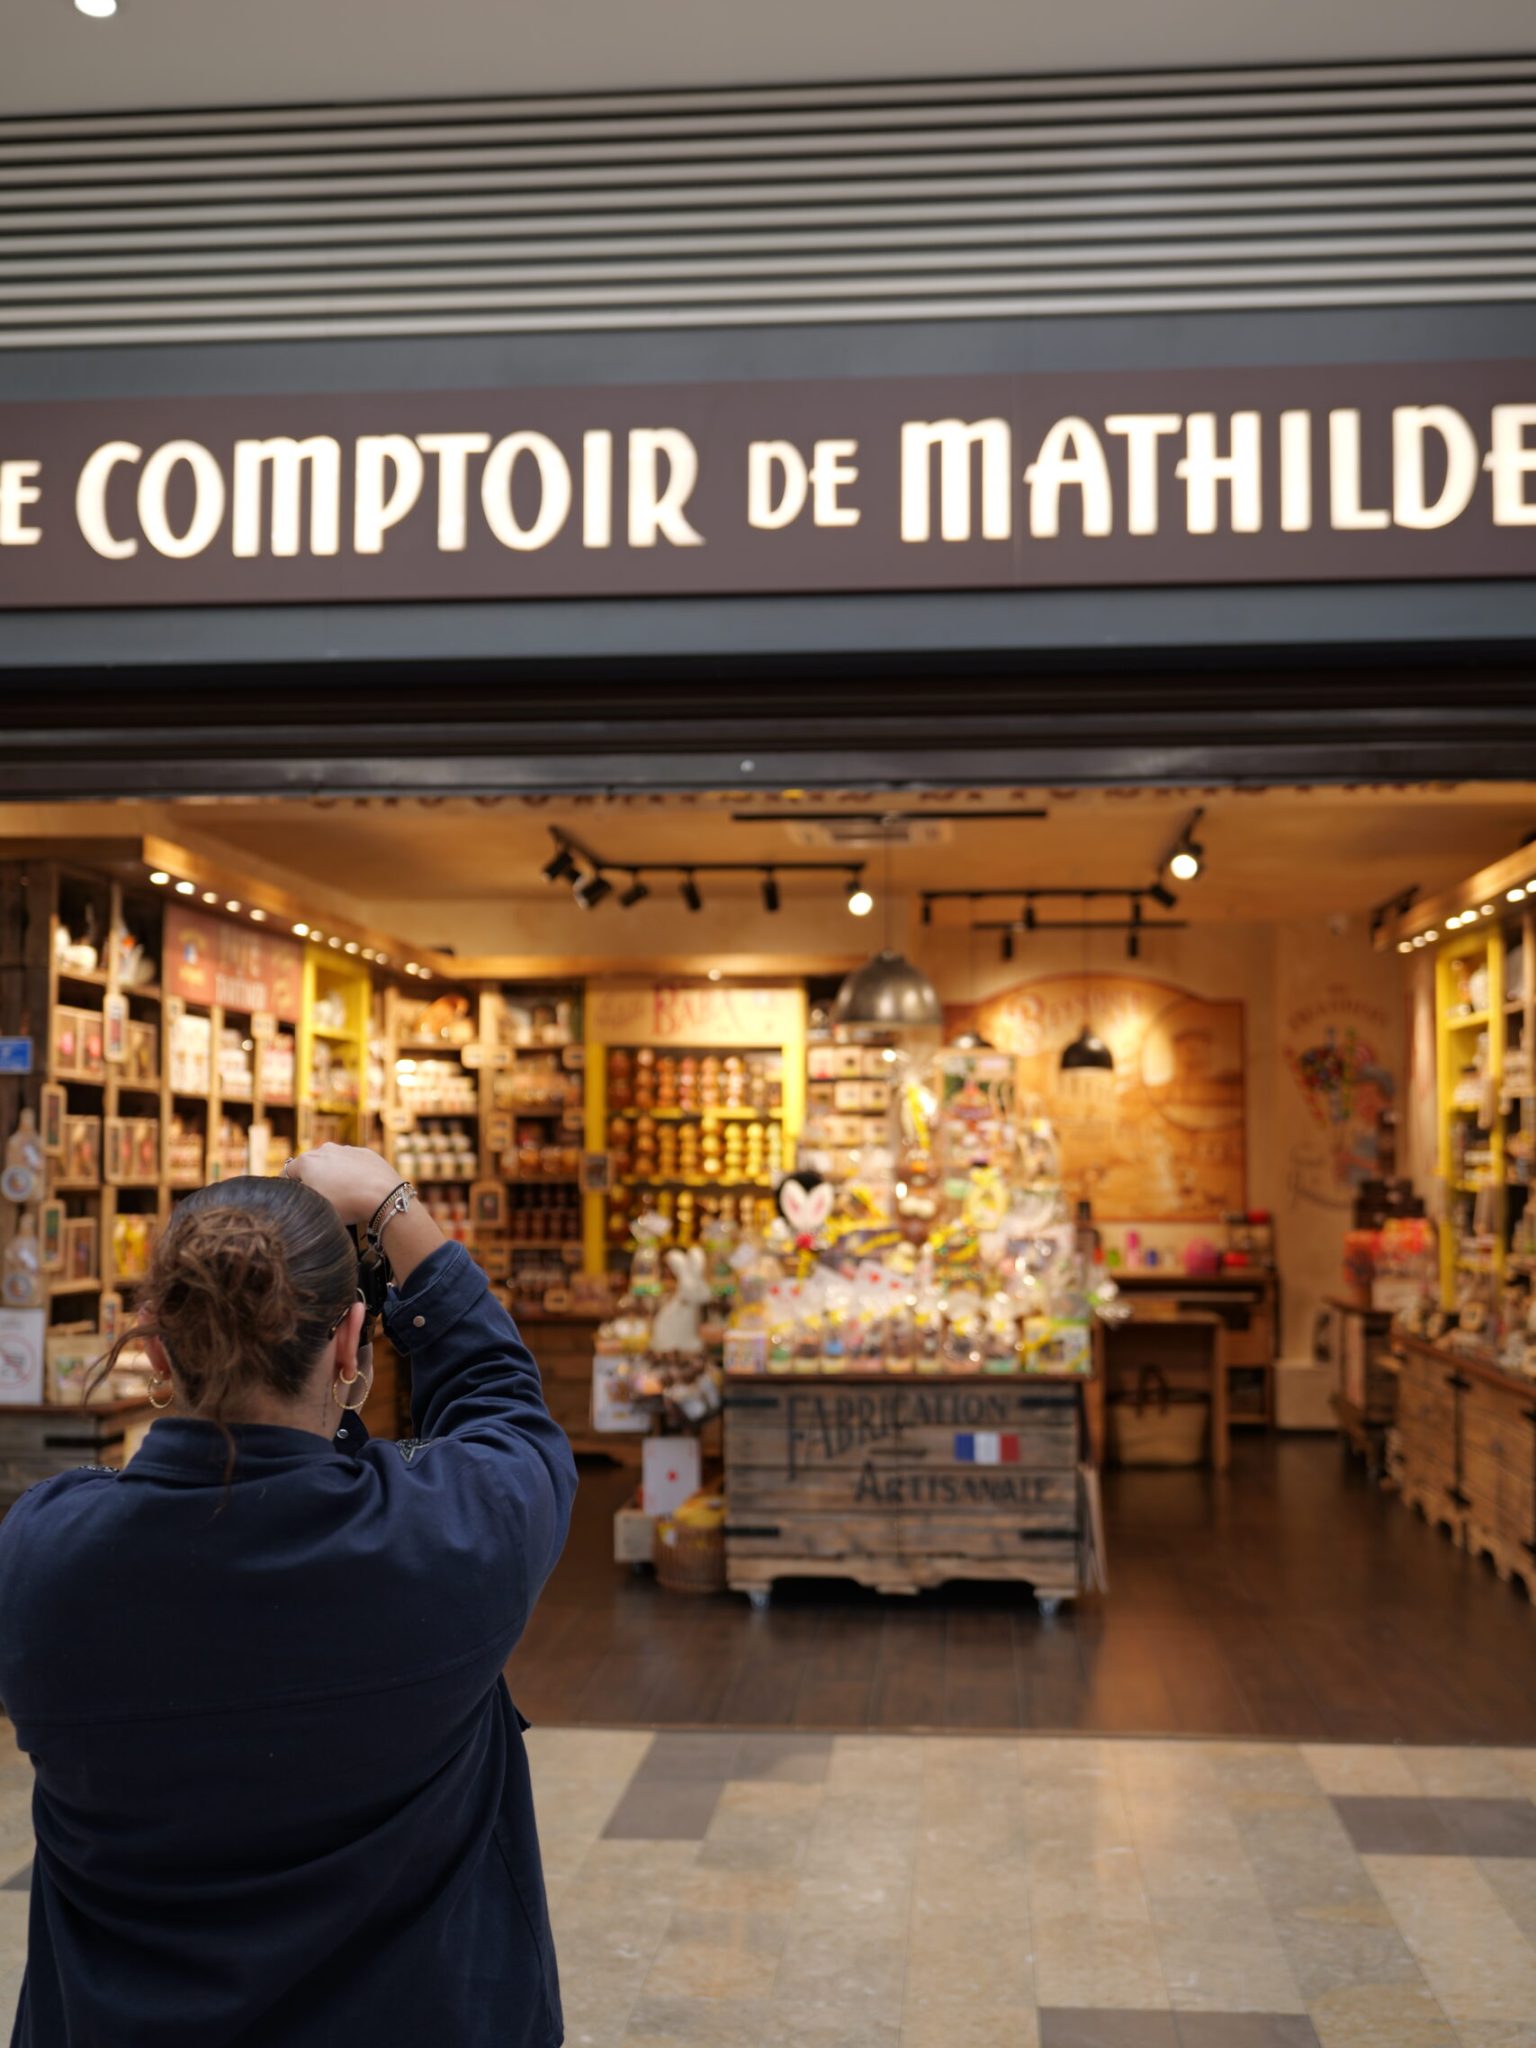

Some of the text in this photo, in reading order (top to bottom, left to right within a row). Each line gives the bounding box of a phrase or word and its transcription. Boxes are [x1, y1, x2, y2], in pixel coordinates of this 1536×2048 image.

[0, 404, 1536, 561] E COMPTOIR DE MATHILDE
[786, 1393, 1011, 1483] FABRICATION
